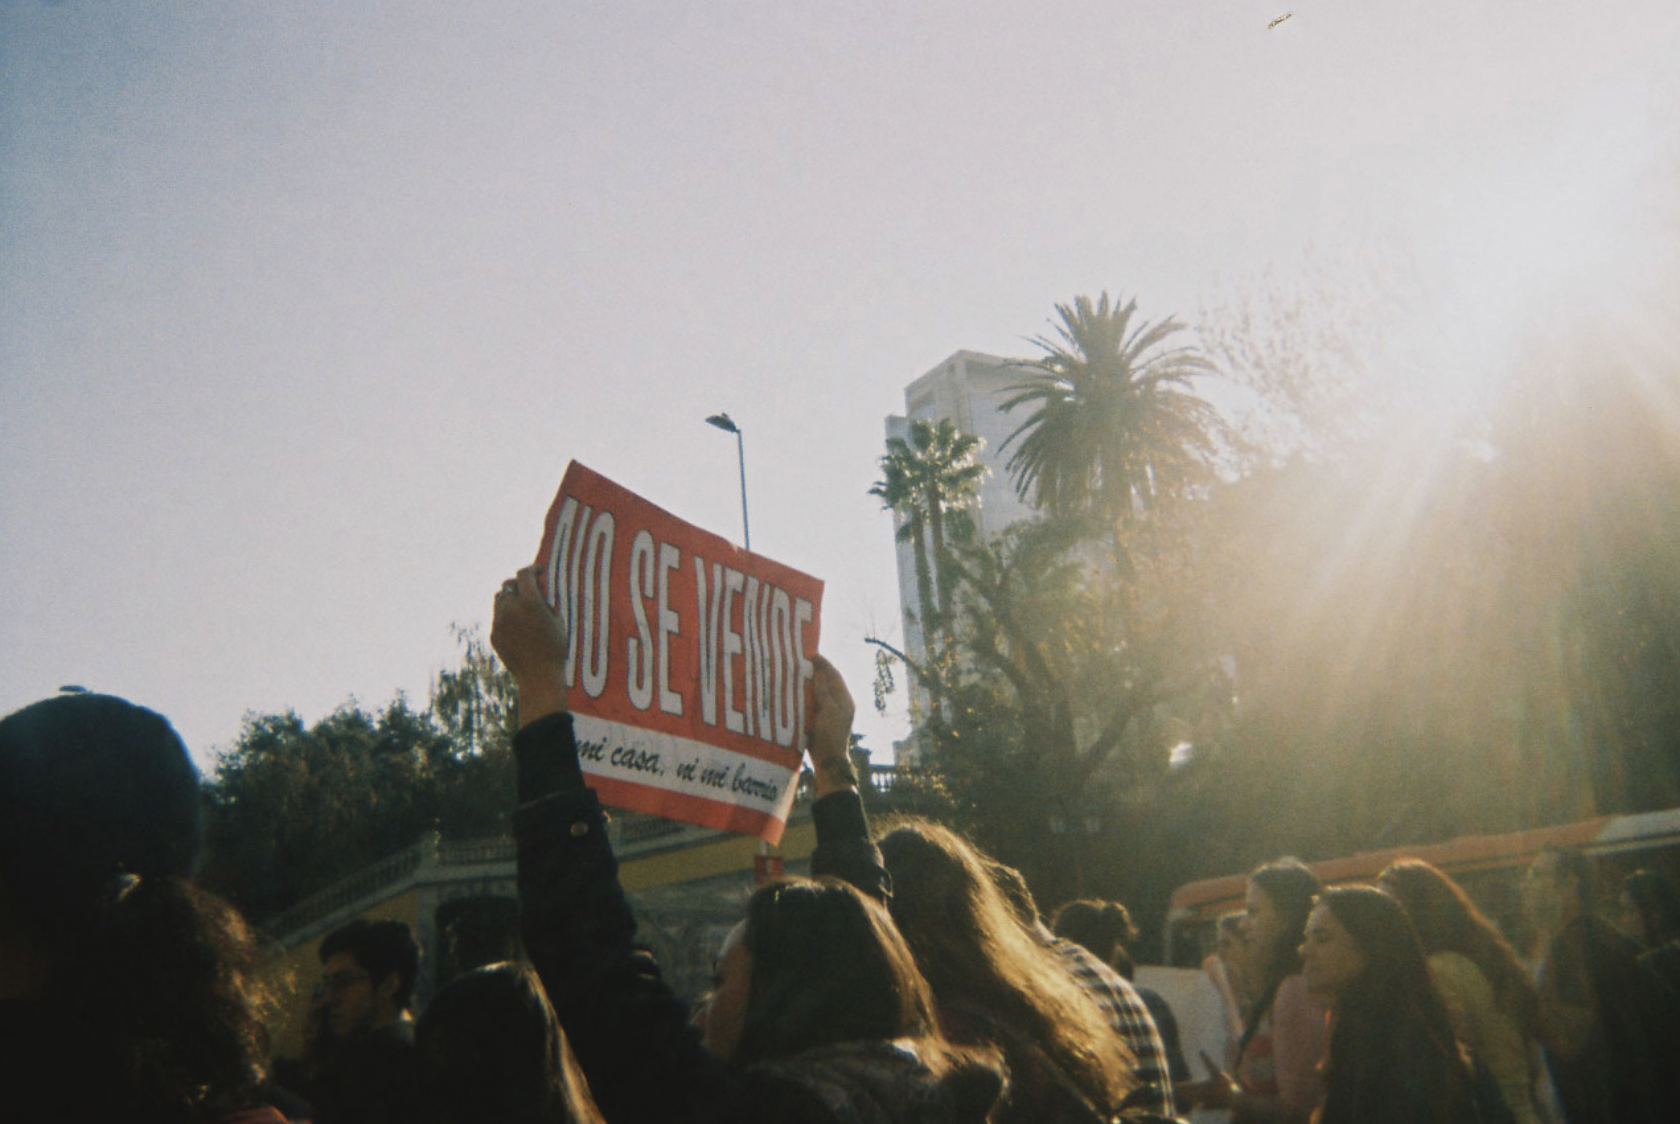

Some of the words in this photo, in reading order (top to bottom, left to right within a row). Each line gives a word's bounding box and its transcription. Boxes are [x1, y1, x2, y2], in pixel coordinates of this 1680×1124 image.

[547, 496, 615, 698] NO
[627, 530, 683, 716] SE
[677, 757, 699, 781] ni
[701, 766, 730, 788] mi
[732, 762, 778, 801] barrio
